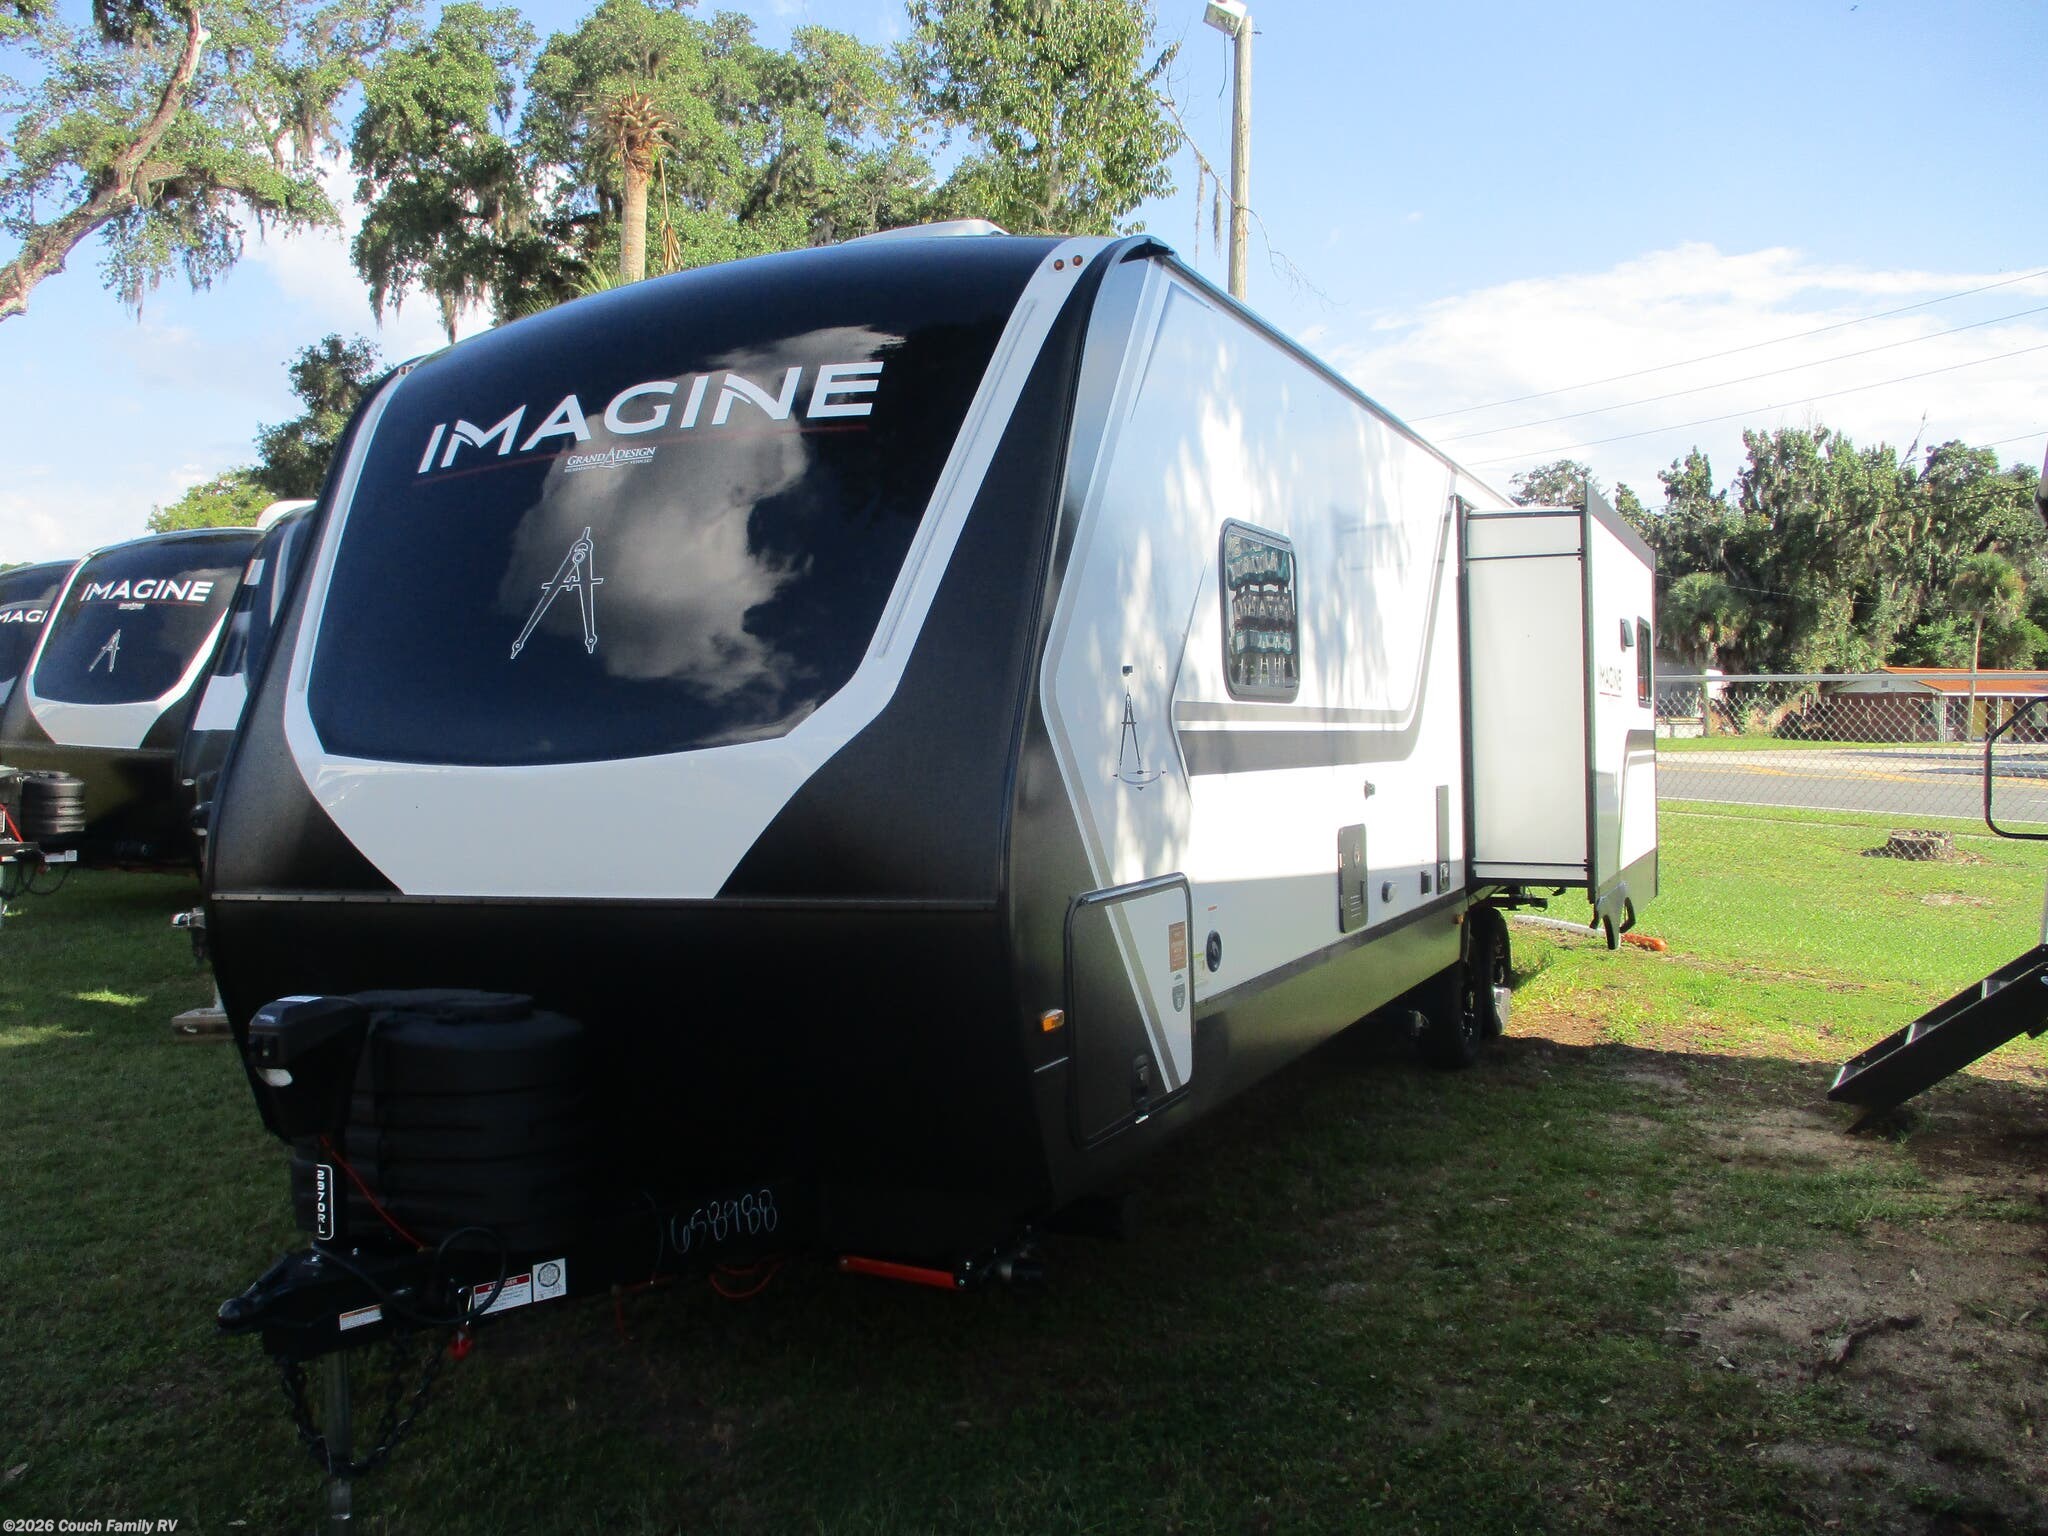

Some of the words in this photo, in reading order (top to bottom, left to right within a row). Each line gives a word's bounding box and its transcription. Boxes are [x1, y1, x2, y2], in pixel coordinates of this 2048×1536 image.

[417, 361, 884, 474] IMAGINE
[567, 452, 605, 466] GRAND
[616, 446, 657, 460] DESIGN
[80, 579, 214, 602] IMAGINE
[316, 1169, 326, 1234] 2970RL
